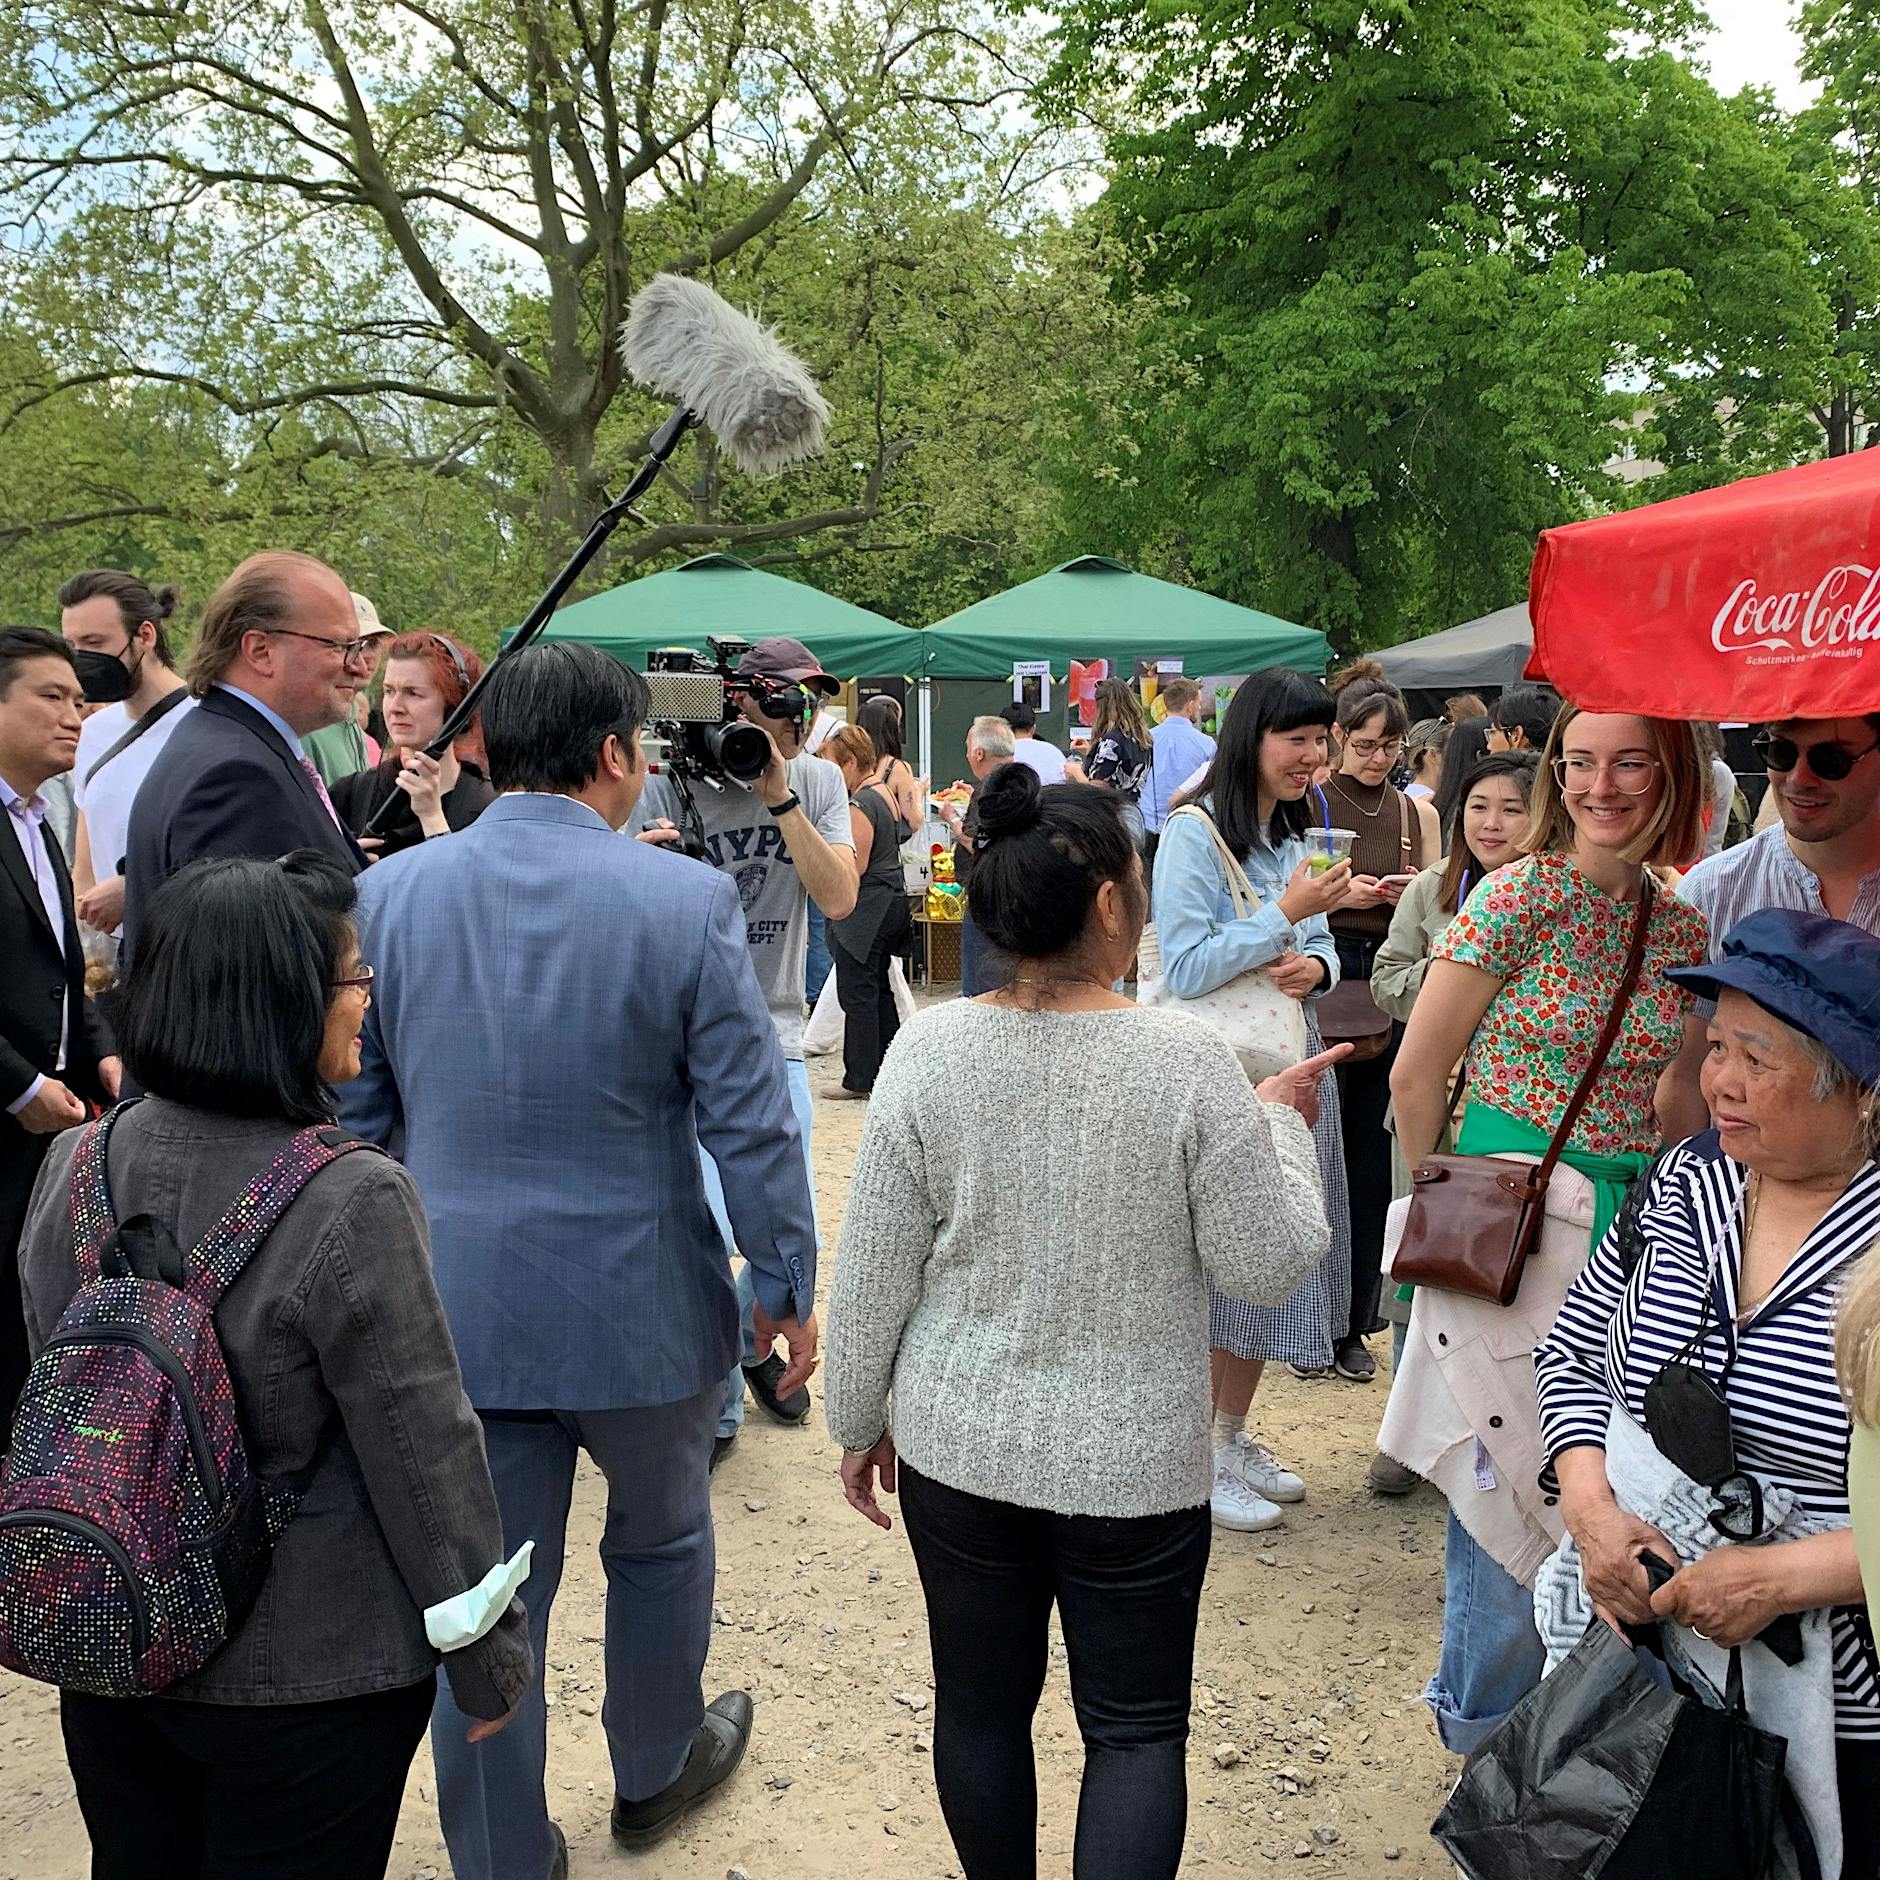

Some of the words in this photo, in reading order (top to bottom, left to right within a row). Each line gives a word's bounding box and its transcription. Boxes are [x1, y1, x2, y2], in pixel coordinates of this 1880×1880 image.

[920, 866, 929, 879] 4
[758, 920, 788, 931] CITY
[747, 933, 775, 944] EPT.
